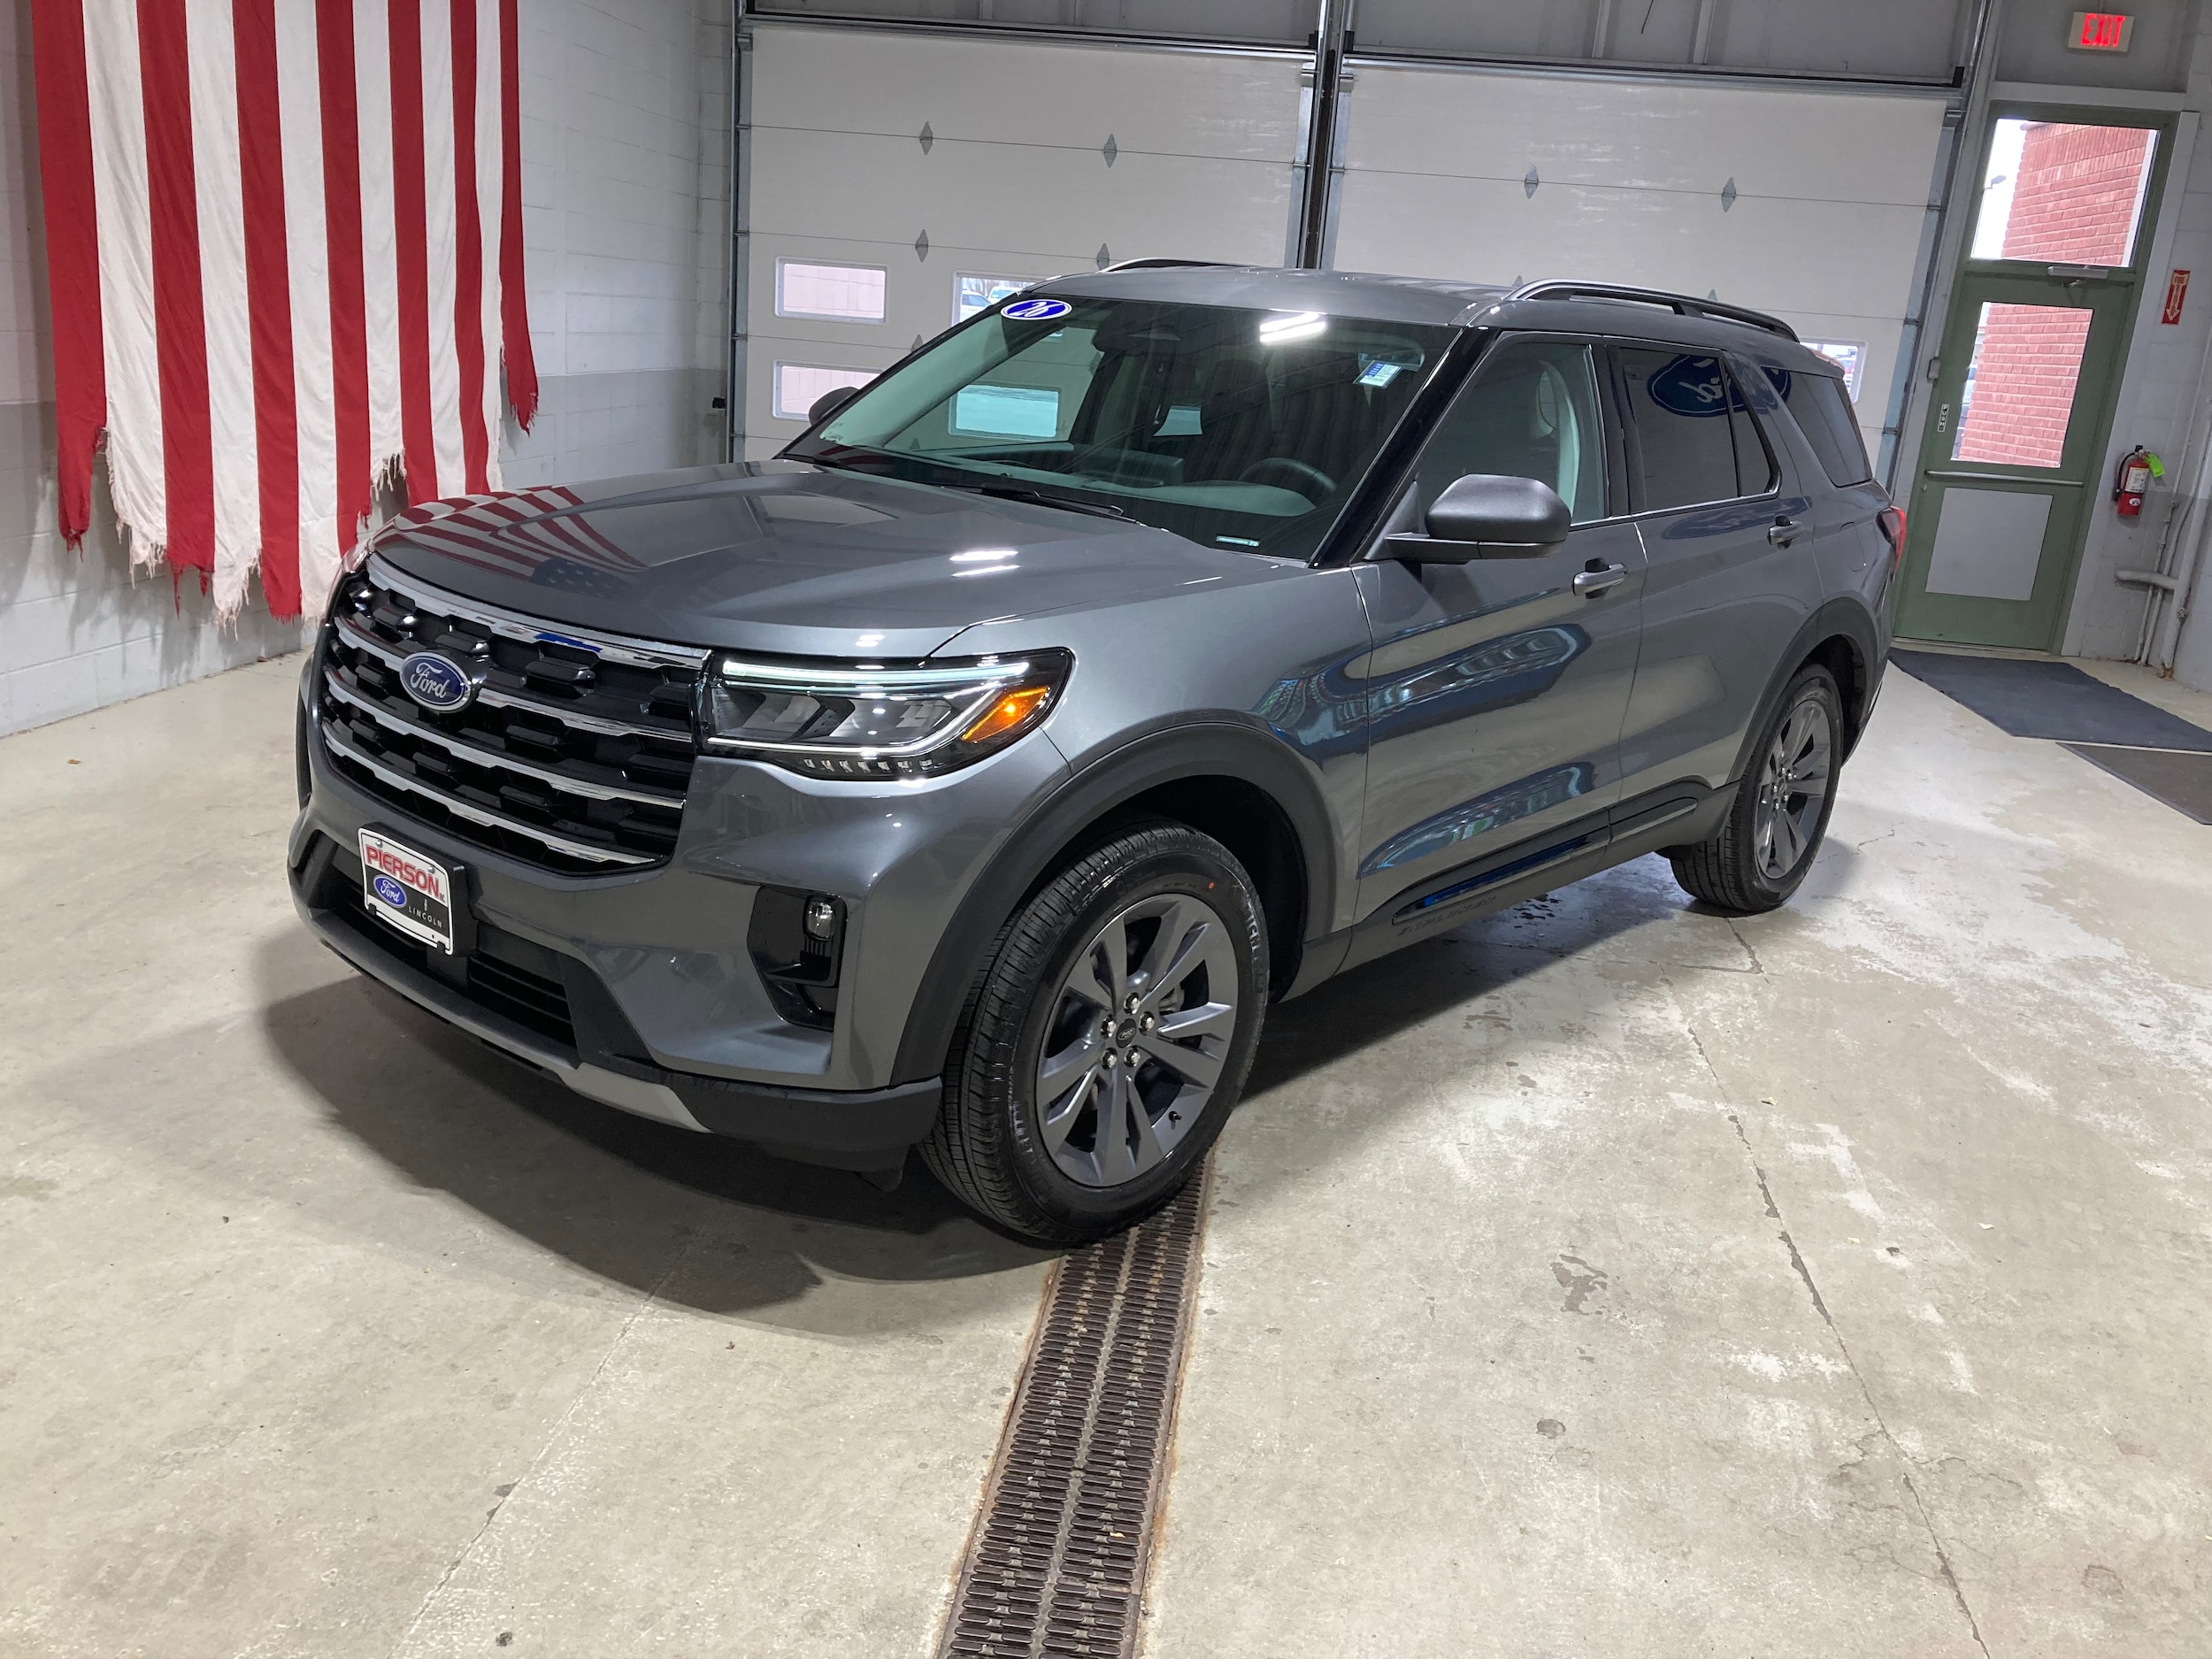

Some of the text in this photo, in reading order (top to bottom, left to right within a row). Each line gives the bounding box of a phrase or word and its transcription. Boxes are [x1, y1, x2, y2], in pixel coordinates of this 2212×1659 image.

[2080, 13, 2125, 48] EXIT
[410, 662, 451, 699] Ford
[365, 843, 440, 899] PIERSON
[380, 878, 400, 903] Ford
[408, 905, 442, 928] LINCOLN
